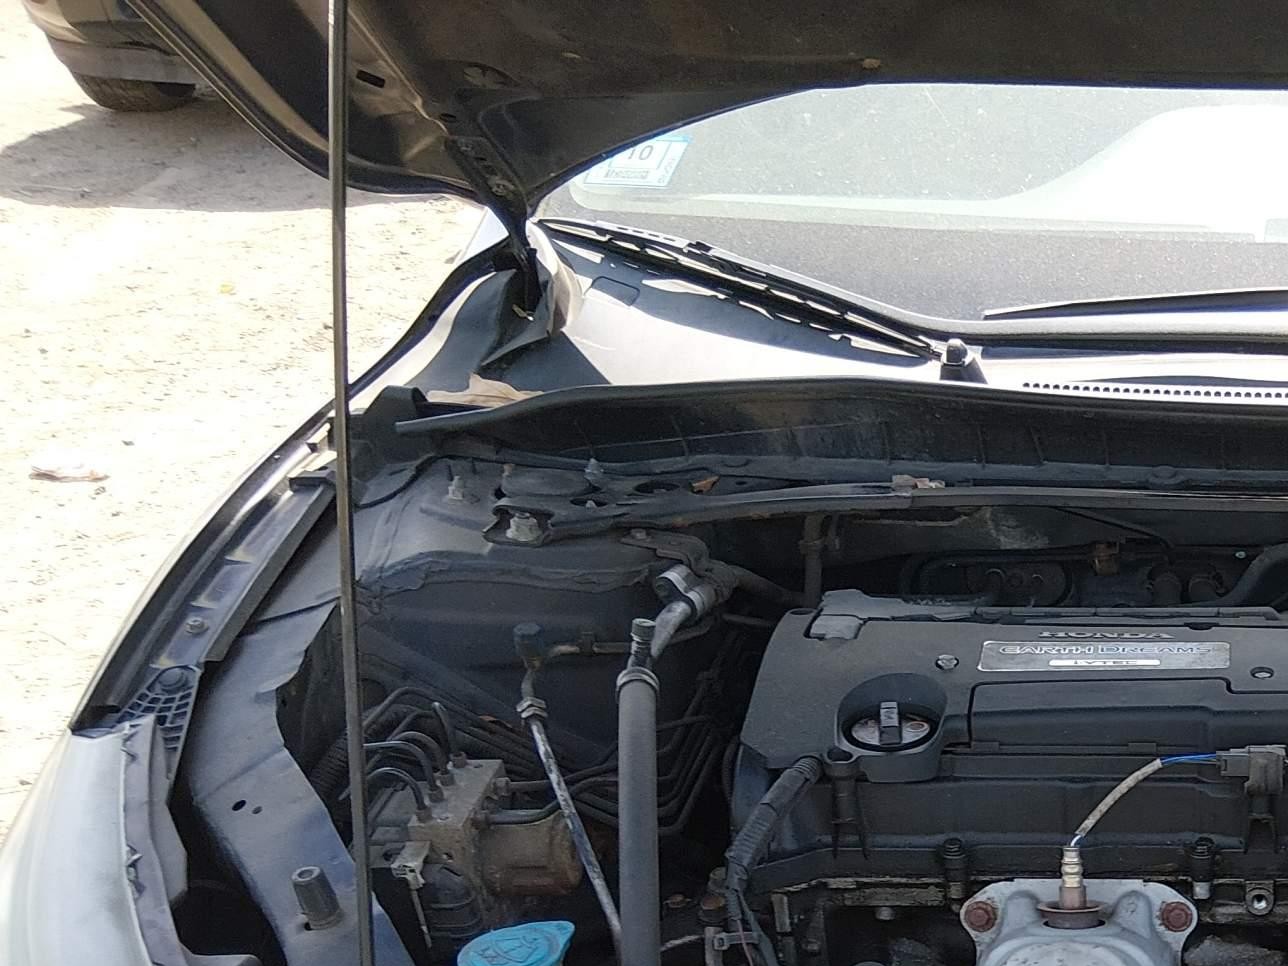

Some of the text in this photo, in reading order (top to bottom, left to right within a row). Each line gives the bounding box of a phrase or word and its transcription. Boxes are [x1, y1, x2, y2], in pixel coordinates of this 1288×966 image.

[1038, 630, 1176, 640] HONDA
[1000, 644, 1212, 655] EARTH DREAMS
